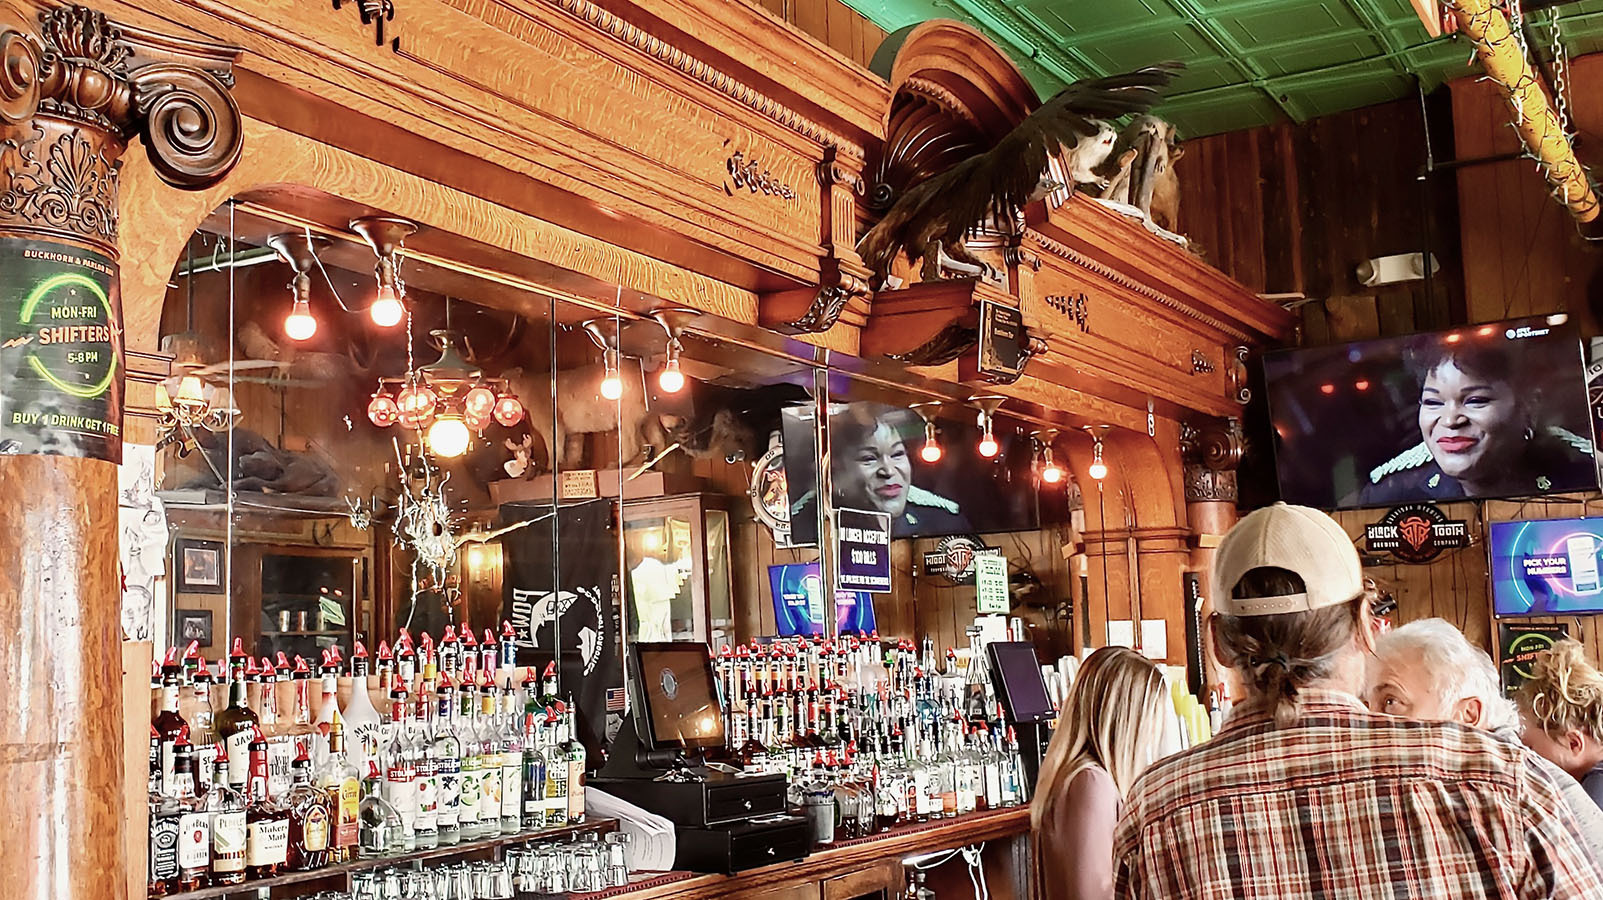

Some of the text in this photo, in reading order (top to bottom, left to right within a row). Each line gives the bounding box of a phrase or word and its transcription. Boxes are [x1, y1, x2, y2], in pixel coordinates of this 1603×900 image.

[24, 250, 74, 264] BUCKHORN
[74, 257, 82, 265] &
[51, 306, 97, 319] MON-FRI
[39, 325, 110, 345] SHIFTERS
[85, 351, 98, 362] PM
[12, 412, 41, 425] BUY
[41, 414, 49, 425] 1
[50, 415, 85, 429] DRINK
[1368, 523, 1465, 539] BLACK TOOTH
[1523, 557, 1567, 568] PICK YOUR
[1516, 652, 1541, 662] SHIFT
